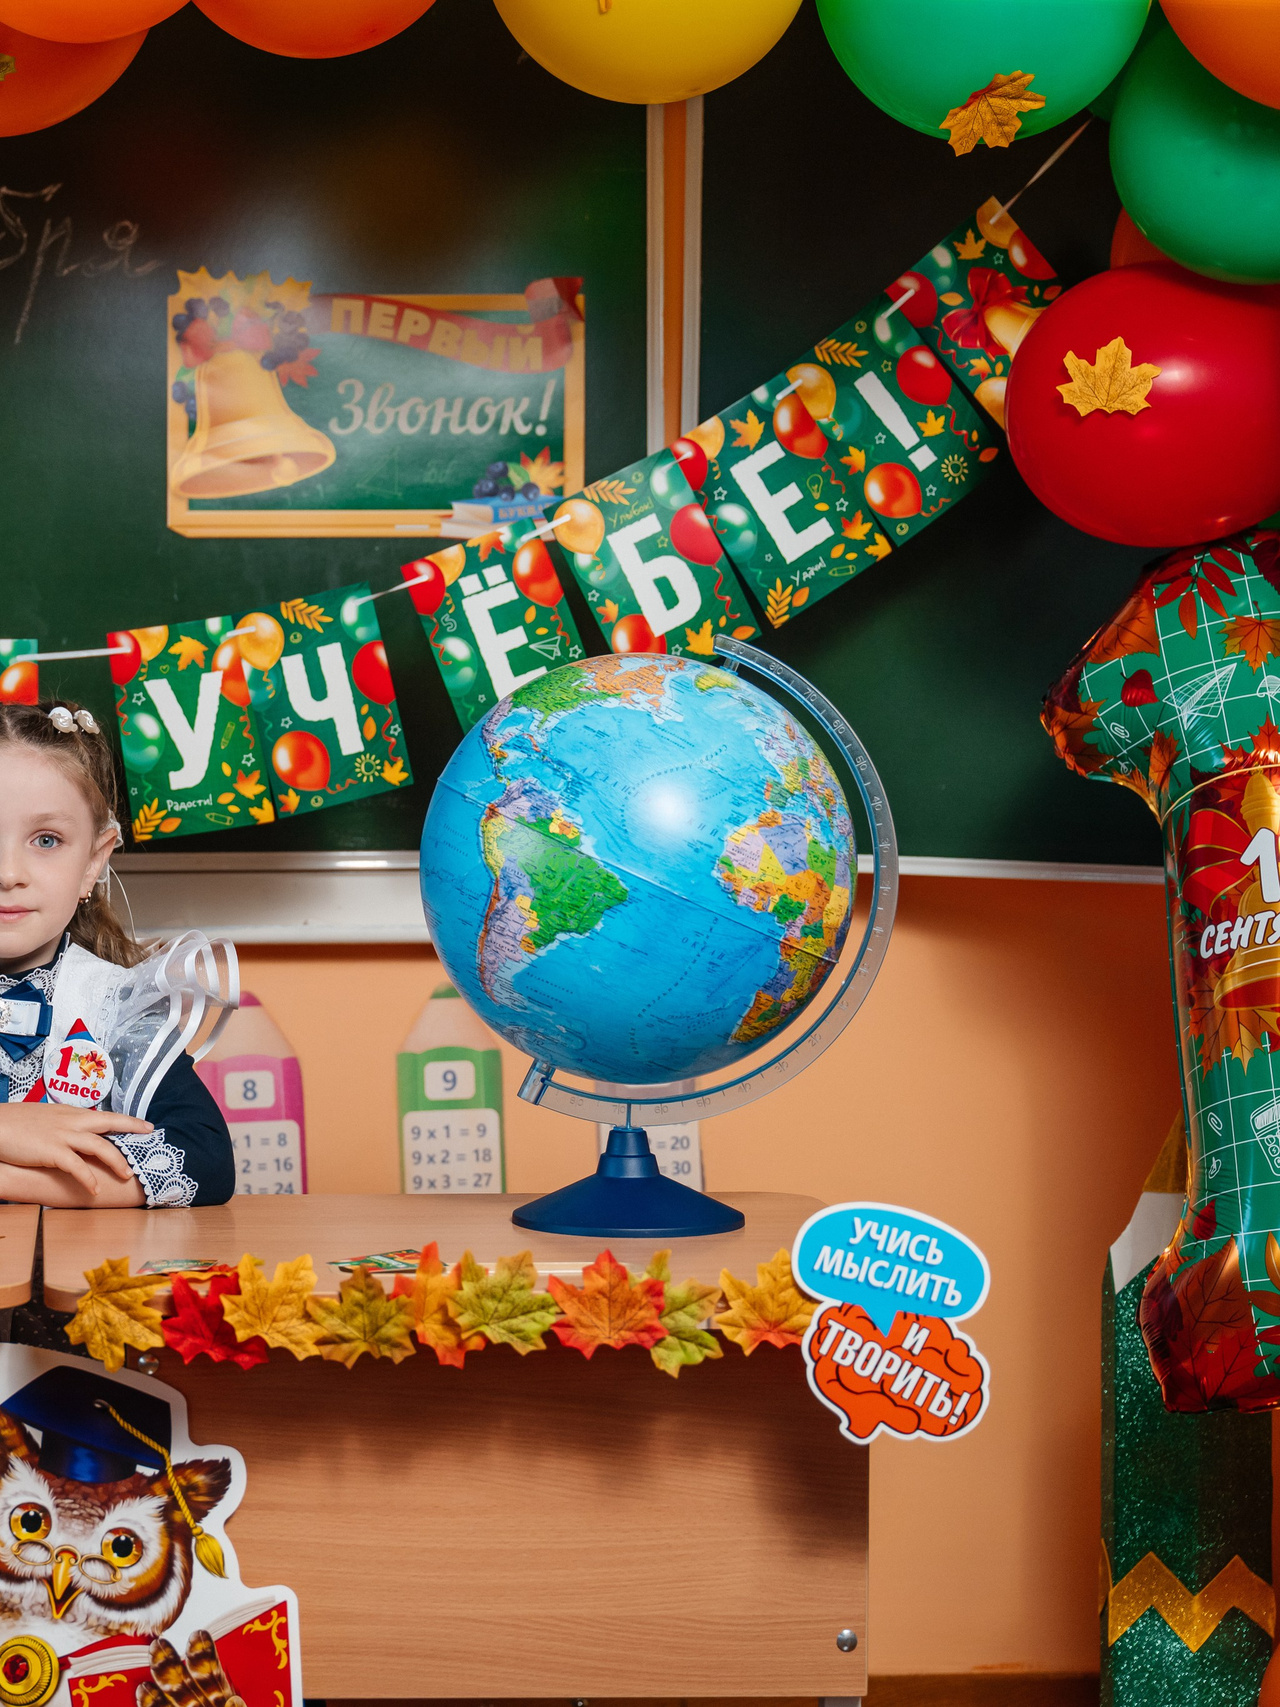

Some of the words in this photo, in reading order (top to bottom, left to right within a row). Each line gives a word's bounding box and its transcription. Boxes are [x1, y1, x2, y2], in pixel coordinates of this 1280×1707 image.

[330, 298, 543, 372] ПЕРВЫЙ
[328, 378, 557, 436] Звонок!
[166, 793, 213, 811] Радости!
[1240, 827, 1280, 903] 1
[56, 1046, 74, 1078] 1
[48, 1078, 101, 1101] класс
[243, 1079, 257, 1101] 8
[442, 1070, 457, 1092] 9
[244, 1135, 251, 1148] 1
[277, 1132, 287, 1147] 8
[411, 1125, 421, 1140] 9
[443, 1125, 450, 1138] 1
[476, 1123, 487, 1138] 9
[670, 1136, 690, 1150] 20
[242, 1159, 251, 1173] 2
[274, 1157, 293, 1172] 16
[412, 1150, 422, 1165] 9
[441, 1149, 450, 1164] 2
[473, 1148, 492, 1162] 18
[672, 1161, 691, 1175] 30
[412, 1175, 423, 1190] 9
[442, 1174, 451, 1189] 3
[473, 1173, 492, 1188] 27
[848, 1217, 944, 1265] УЧИСЬ
[813, 1245, 962, 1307] МЫСЛИТЬ
[901, 1322, 931, 1356] И
[818, 1319, 971, 1426] ТВОРИТЬ!
